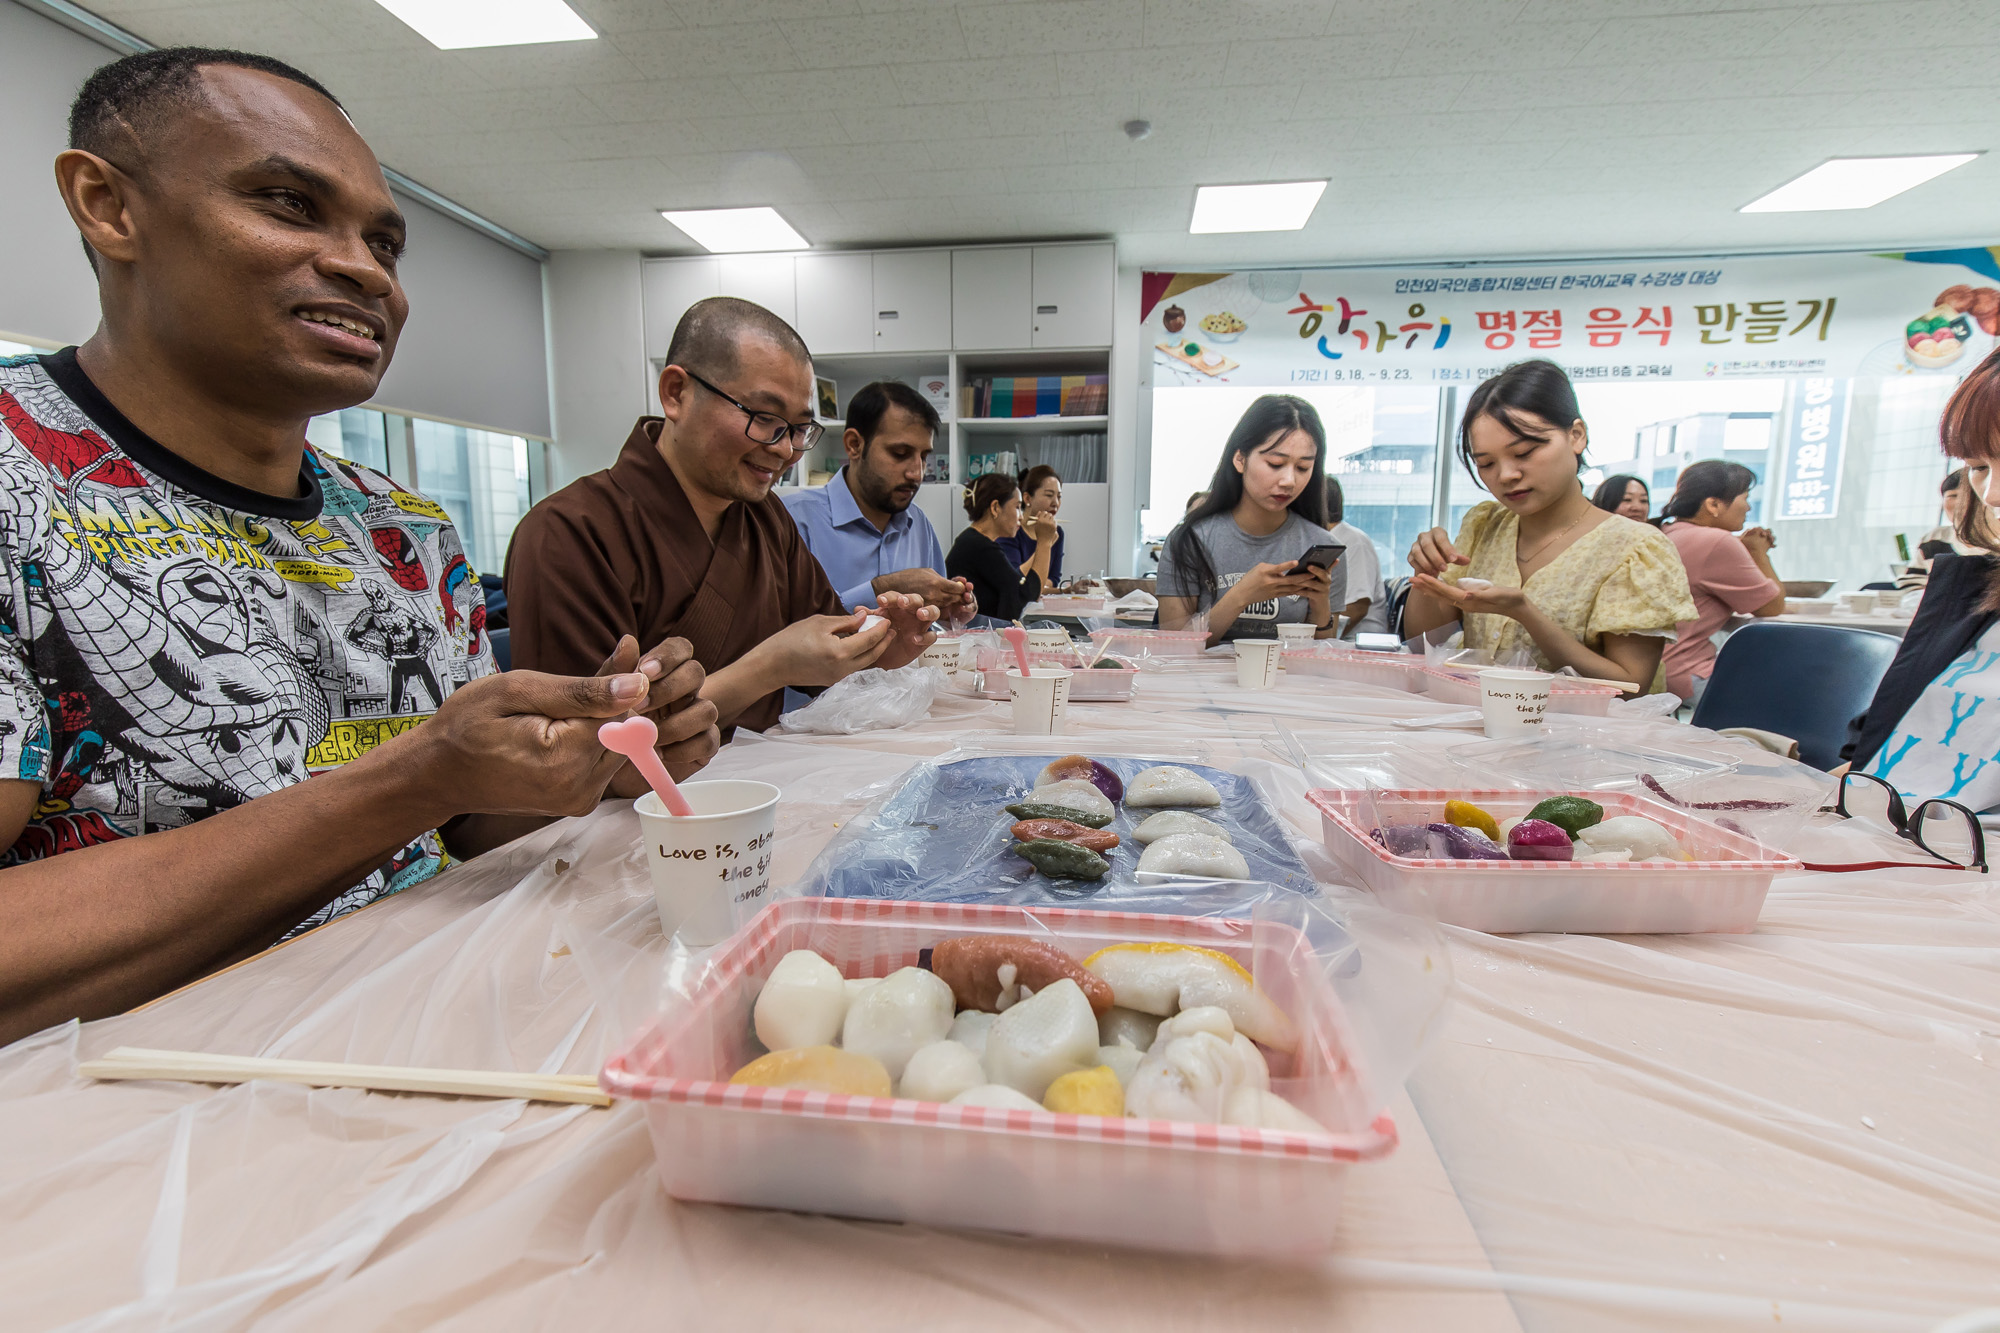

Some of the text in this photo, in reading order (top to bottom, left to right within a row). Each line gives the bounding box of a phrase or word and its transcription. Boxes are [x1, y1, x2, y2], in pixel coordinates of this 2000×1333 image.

[1395, 269, 1722, 294] 인천외국인종합지원센터 한국어교육 수강생 대상
[1287, 293, 1837, 360] 한가위 명절 음식 만들기
[1488, 690, 1511, 699] Love
[1515, 692, 1528, 702] is,
[1516, 704, 1534, 713] the
[659, 844, 707, 860] Love
[715, 843, 739, 859] is,
[719, 866, 753, 882] the
